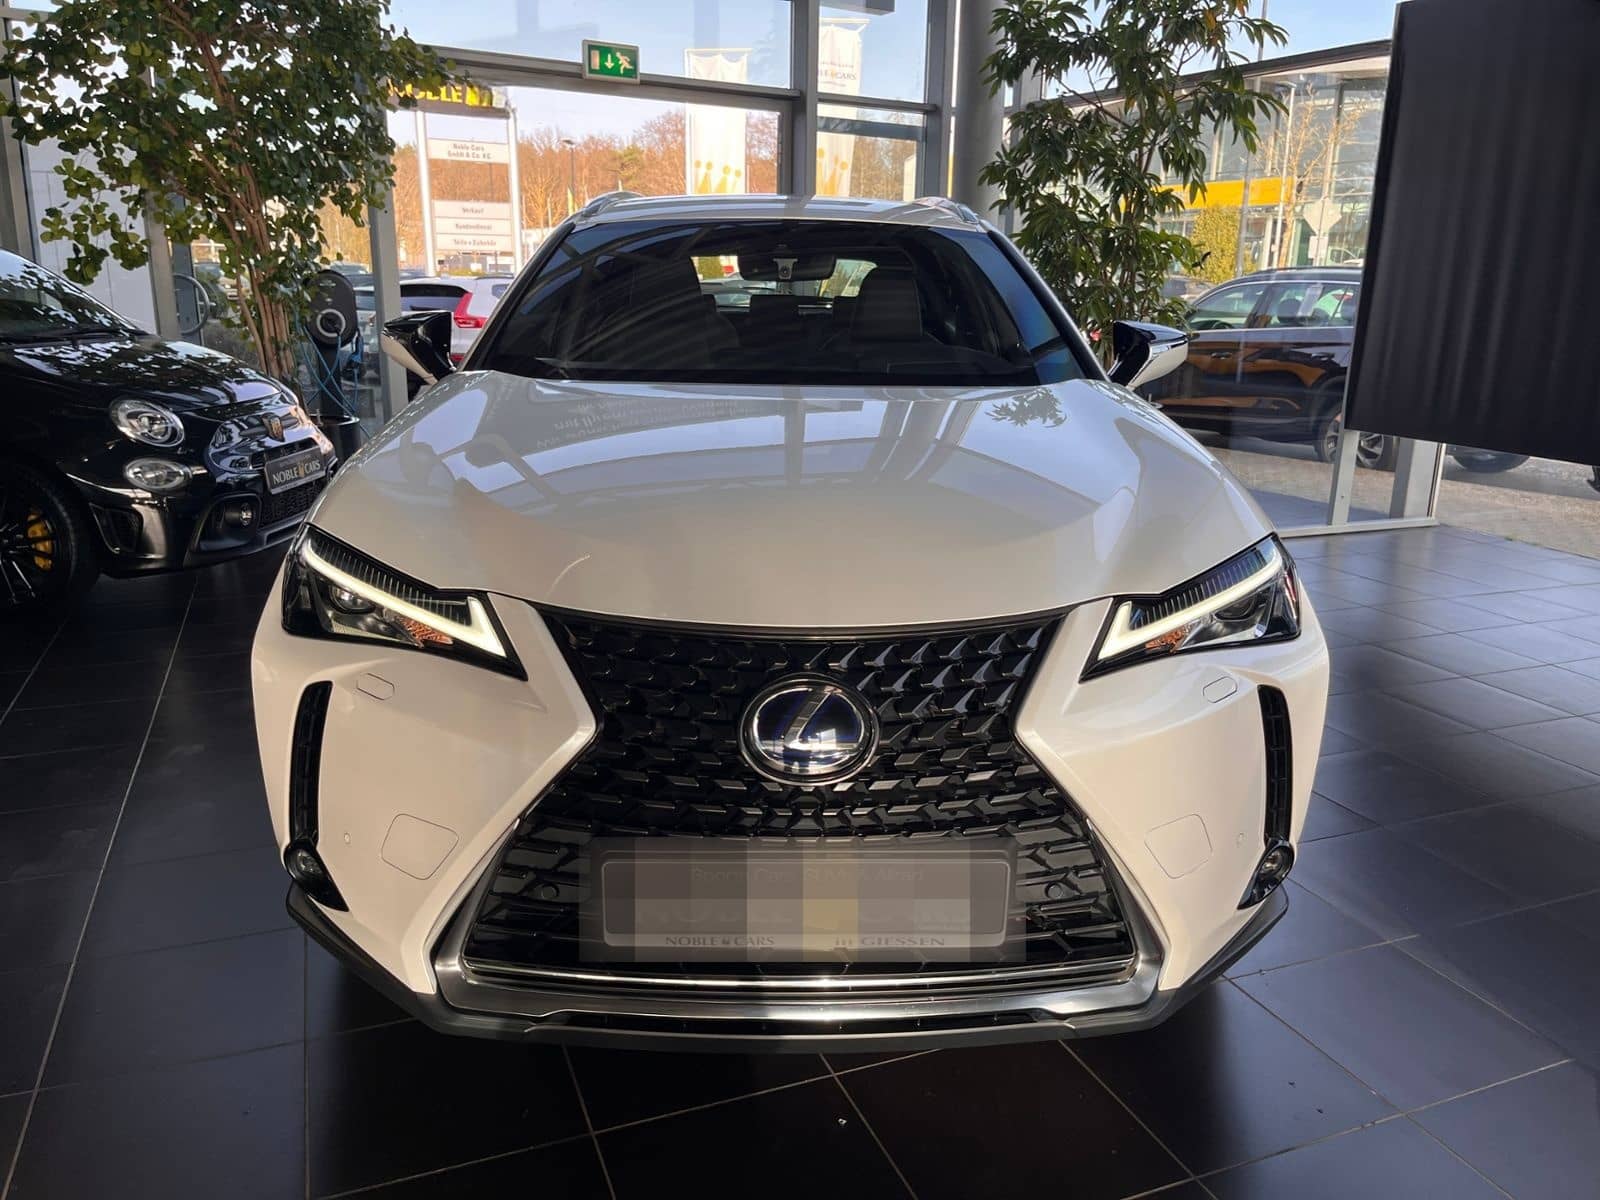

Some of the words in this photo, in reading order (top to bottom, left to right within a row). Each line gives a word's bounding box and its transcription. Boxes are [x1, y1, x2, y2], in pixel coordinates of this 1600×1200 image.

[272, 467, 299, 485] NOBLE
[304, 460, 321, 475] CARS
[665, 937, 723, 946] NOBLE
[733, 937, 775, 946] CARS
[860, 937, 946, 946] GIESSEN
